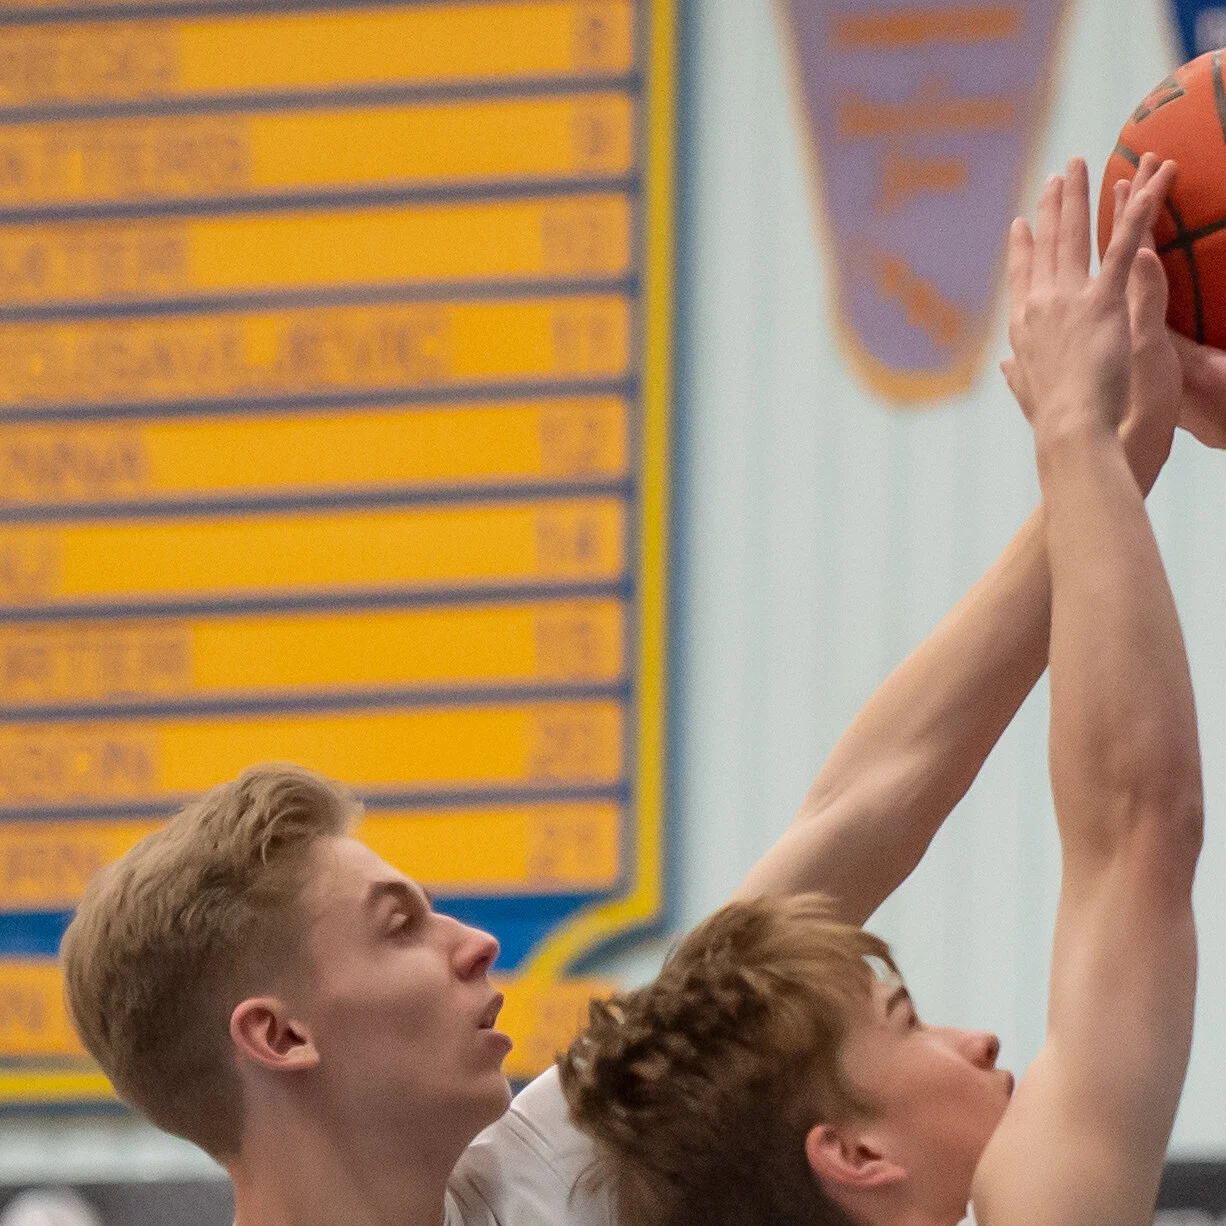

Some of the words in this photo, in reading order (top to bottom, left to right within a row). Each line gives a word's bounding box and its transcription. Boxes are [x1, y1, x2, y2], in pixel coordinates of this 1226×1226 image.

[0, 432, 153, 492] NNA
[0, 630, 194, 692] RTER
[0, 733, 157, 794] SON
